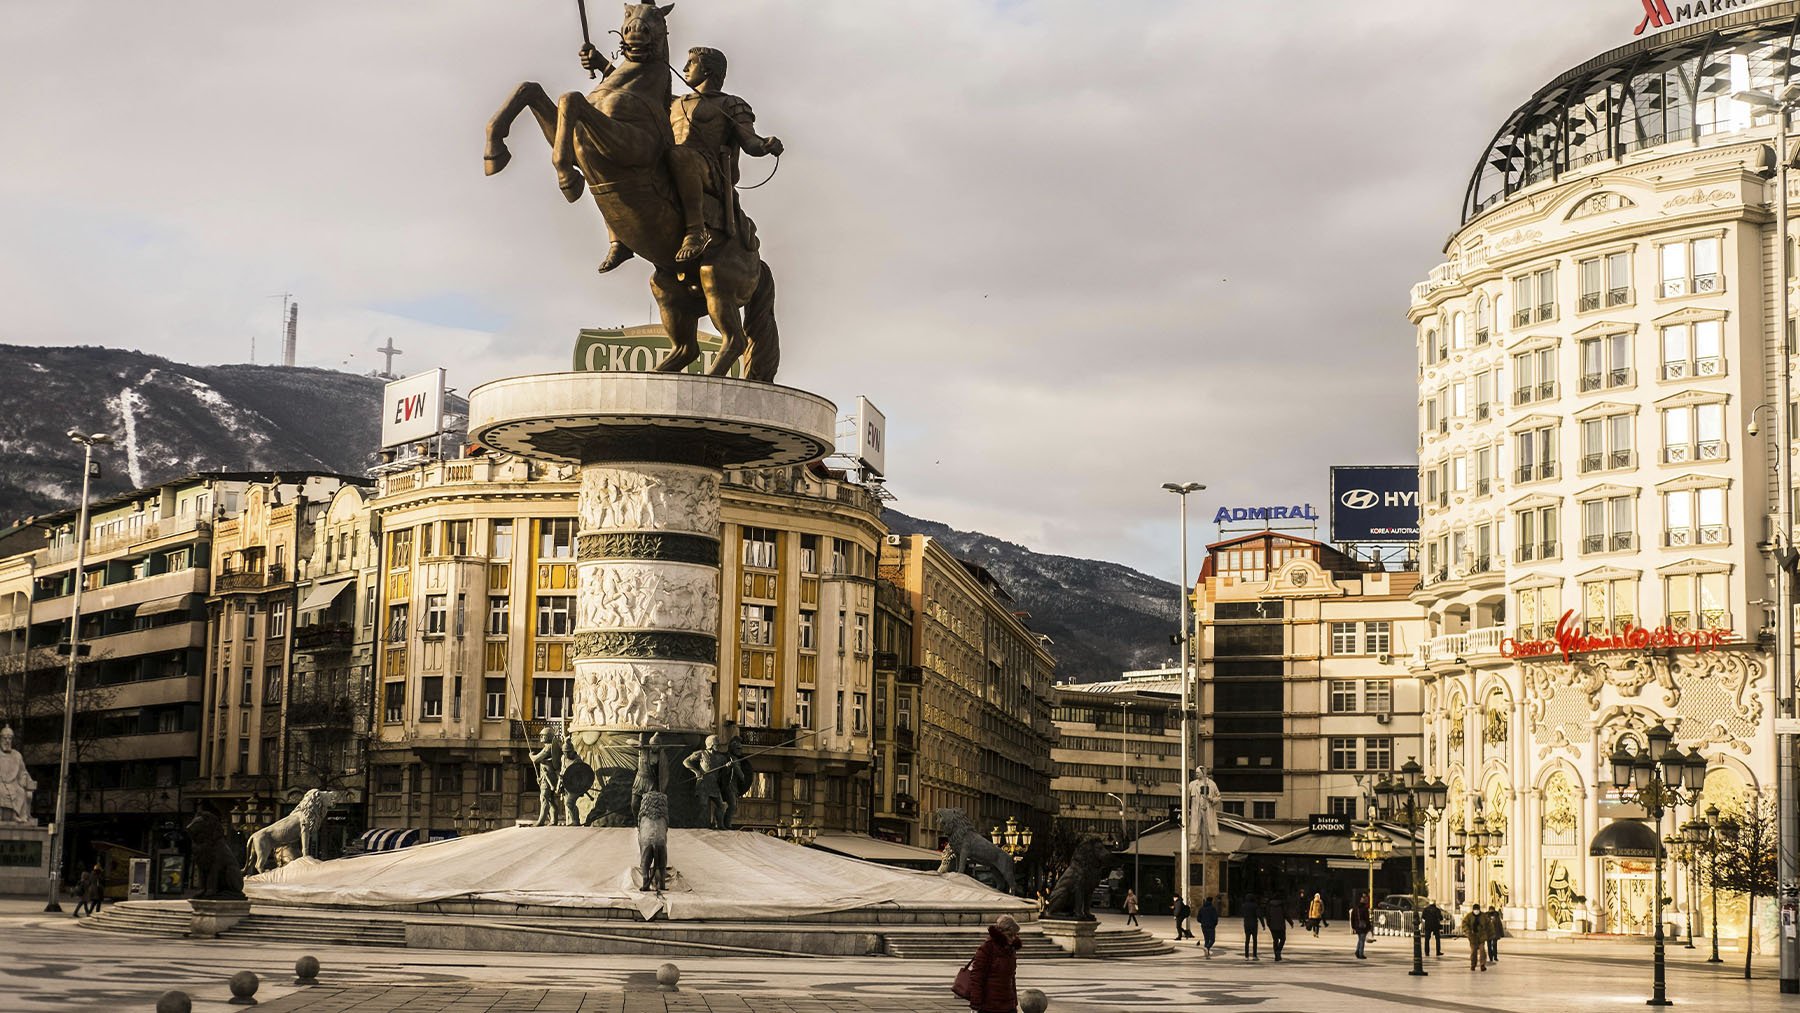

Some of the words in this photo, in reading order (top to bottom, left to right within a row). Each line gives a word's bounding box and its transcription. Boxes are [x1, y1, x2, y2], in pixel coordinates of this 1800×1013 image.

[1676, 0, 1747, 22] MARR
[394, 391, 427, 425] EVN
[867, 420, 881, 453] EVN
[1212, 503, 1320, 524] ADMIRAL
[1370, 527, 1389, 535] KOREA
[1651, 625, 1732, 655] Skopje
[1312, 823, 1345, 831] LONDON
